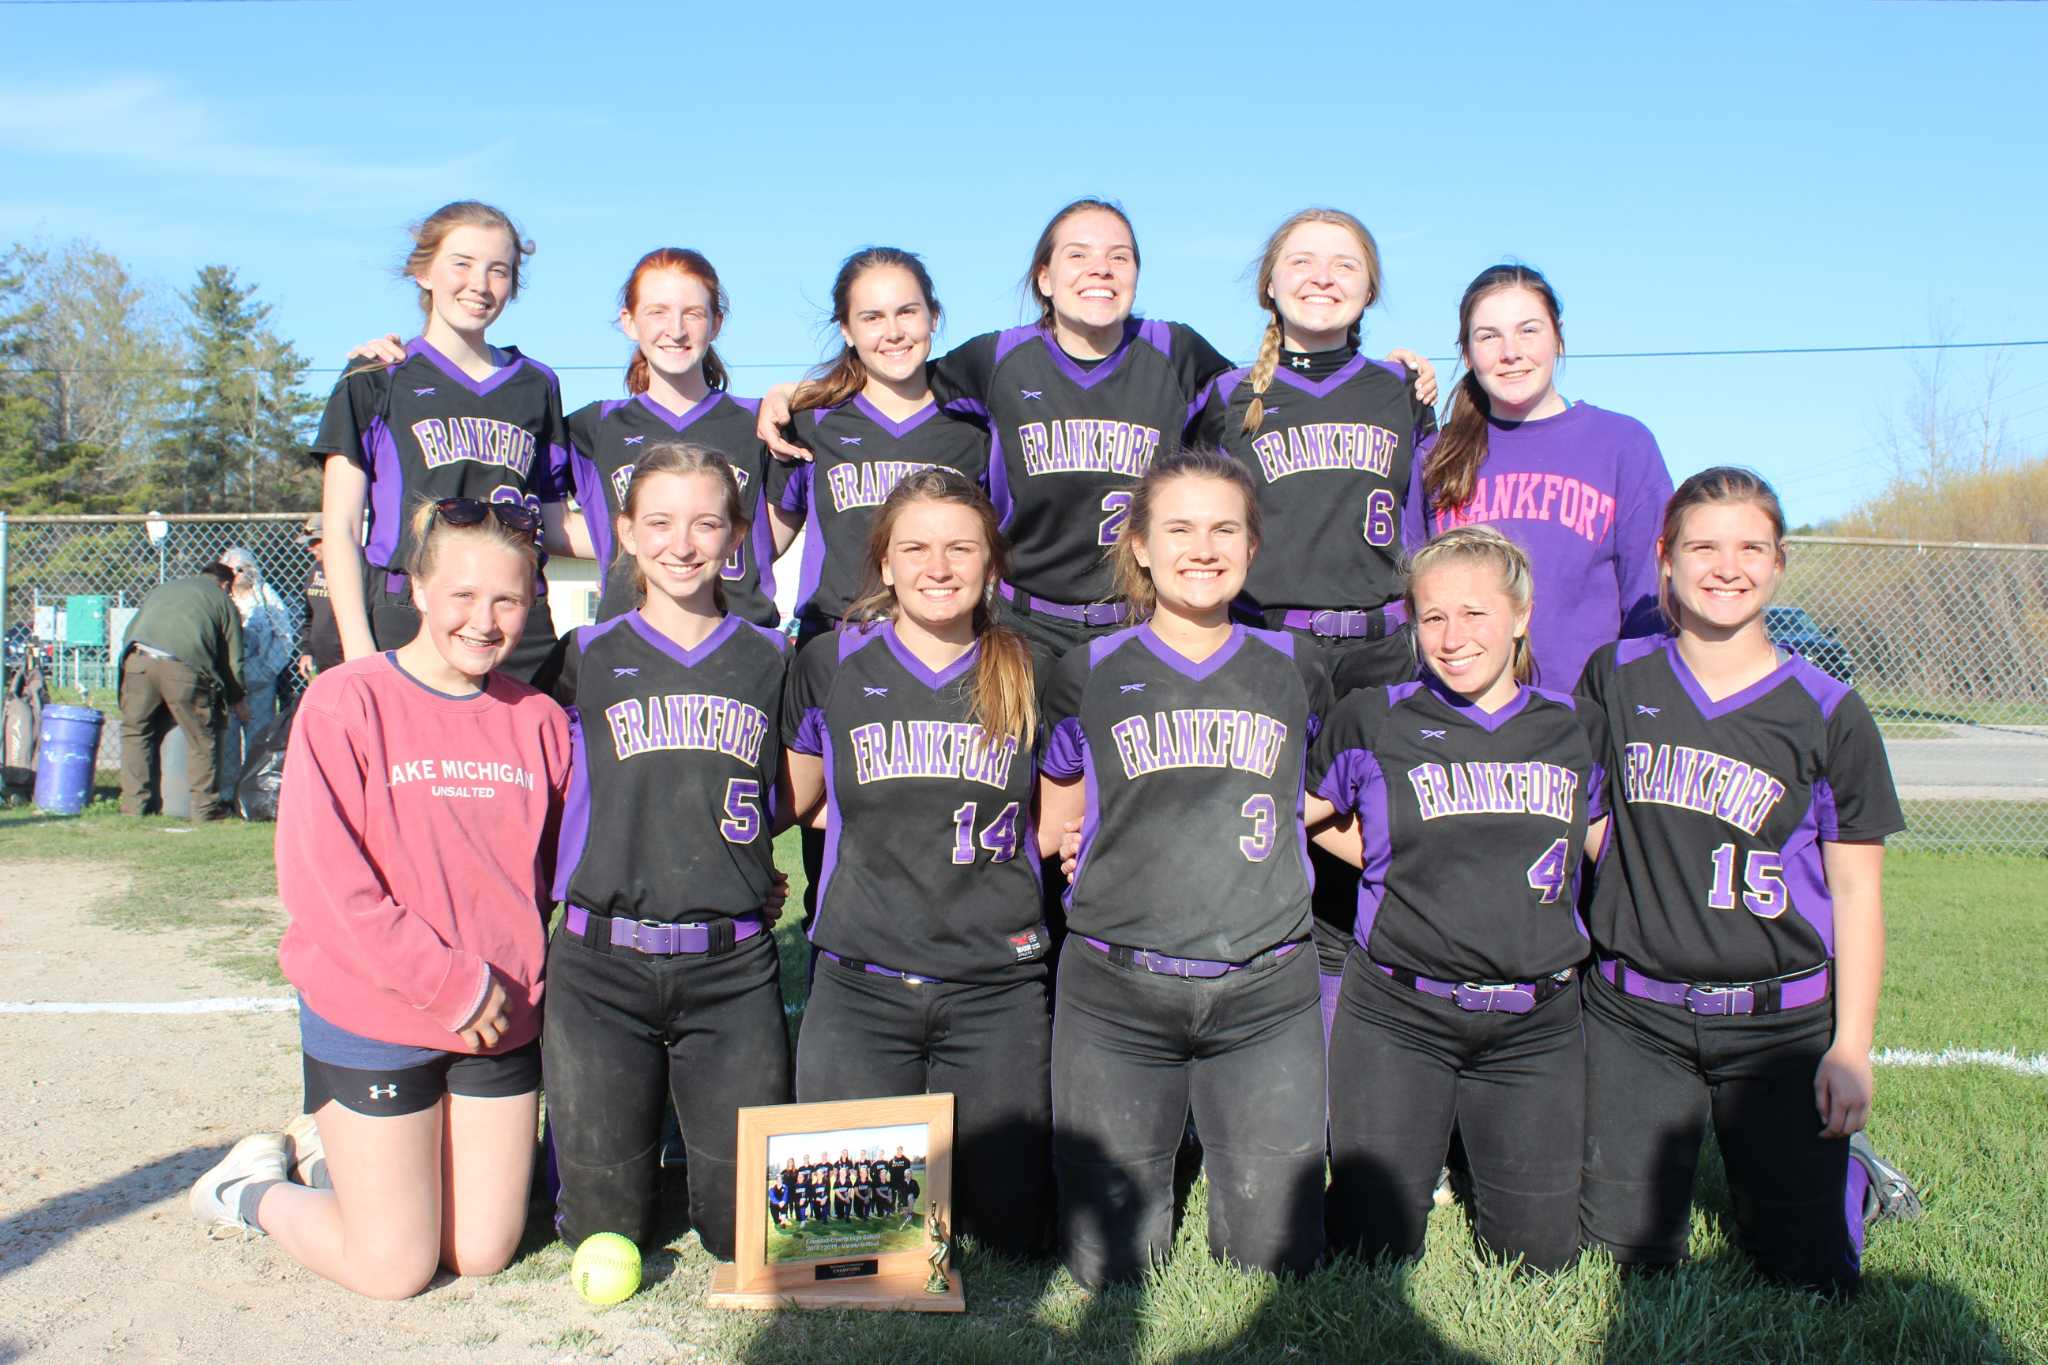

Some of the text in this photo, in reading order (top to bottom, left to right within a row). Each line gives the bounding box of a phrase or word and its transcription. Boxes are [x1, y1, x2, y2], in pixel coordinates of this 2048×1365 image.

[411, 416, 536, 480] FRANKFOR
[1019, 419, 1160, 479] FRANKFORT
[1251, 422, 1399, 484] FRANKFORT
[1098, 491, 1134, 546] 2
[1363, 488, 1395, 547] 6
[605, 694, 768, 768] FRANKFORT
[850, 720, 1018, 790] FRANKFORT
[1111, 709, 1288, 780] FRANKFORT
[387, 759, 535, 791] AKE MICHIGAN
[431, 785, 495, 799] UNSALTED
[1407, 761, 1578, 824] FRANKFORT
[1625, 742, 1786, 837] FRANKFORT
[720, 777, 760, 845] 5
[952, 801, 1019, 865] 14
[1239, 793, 1277, 863] 3
[1526, 838, 1569, 904] 4
[1708, 842, 1788, 919] 15
